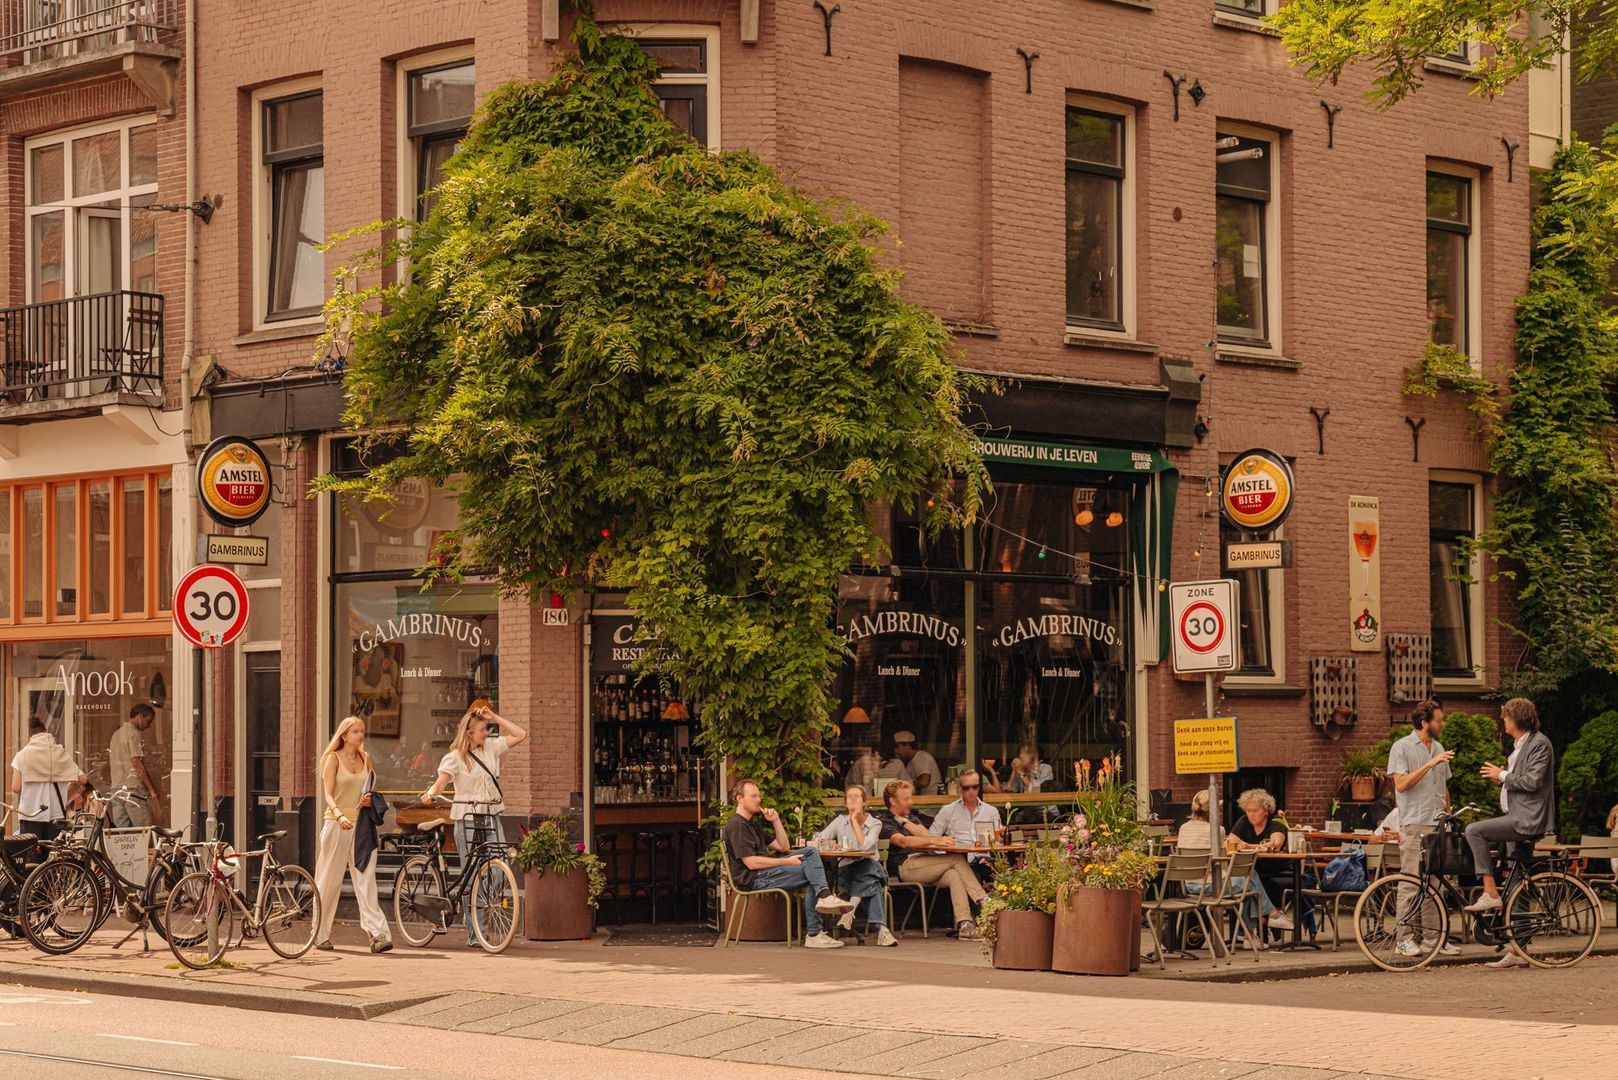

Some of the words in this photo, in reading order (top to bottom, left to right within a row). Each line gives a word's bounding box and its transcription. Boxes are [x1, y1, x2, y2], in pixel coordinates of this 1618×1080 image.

[1037, 446, 1048, 460] IN
[1050, 447, 1062, 461] JE
[1064, 448, 1098, 464] LEVEN
[219, 468, 263, 483] AMSTEL
[231, 484, 255, 495] BIER
[1230, 479, 1273, 494] AMSTEL
[1238, 494, 1262, 505] BIER
[209, 543, 265, 557] GAMBRINUS
[1229, 549, 1281, 561] GAMBRINUS
[1187, 587, 1215, 598] ZONE
[190, 591, 236, 621] 30
[544, 609, 568, 624] 180
[1188, 616, 1217, 636] 30
[400, 667, 417, 678] Lunch
[418, 667, 423, 678] &
[425, 667, 443, 677] Dinner
[878, 665, 895, 676] Lunch
[896, 666, 901, 676] &
[902, 665, 921, 676] Dinner
[1042, 667, 1057, 677] Lunch
[1058, 667, 1063, 677] &
[1064, 667, 1081, 678] Dinner
[54, 660, 134, 697] Anook
[1176, 726, 1190, 734] Denk
